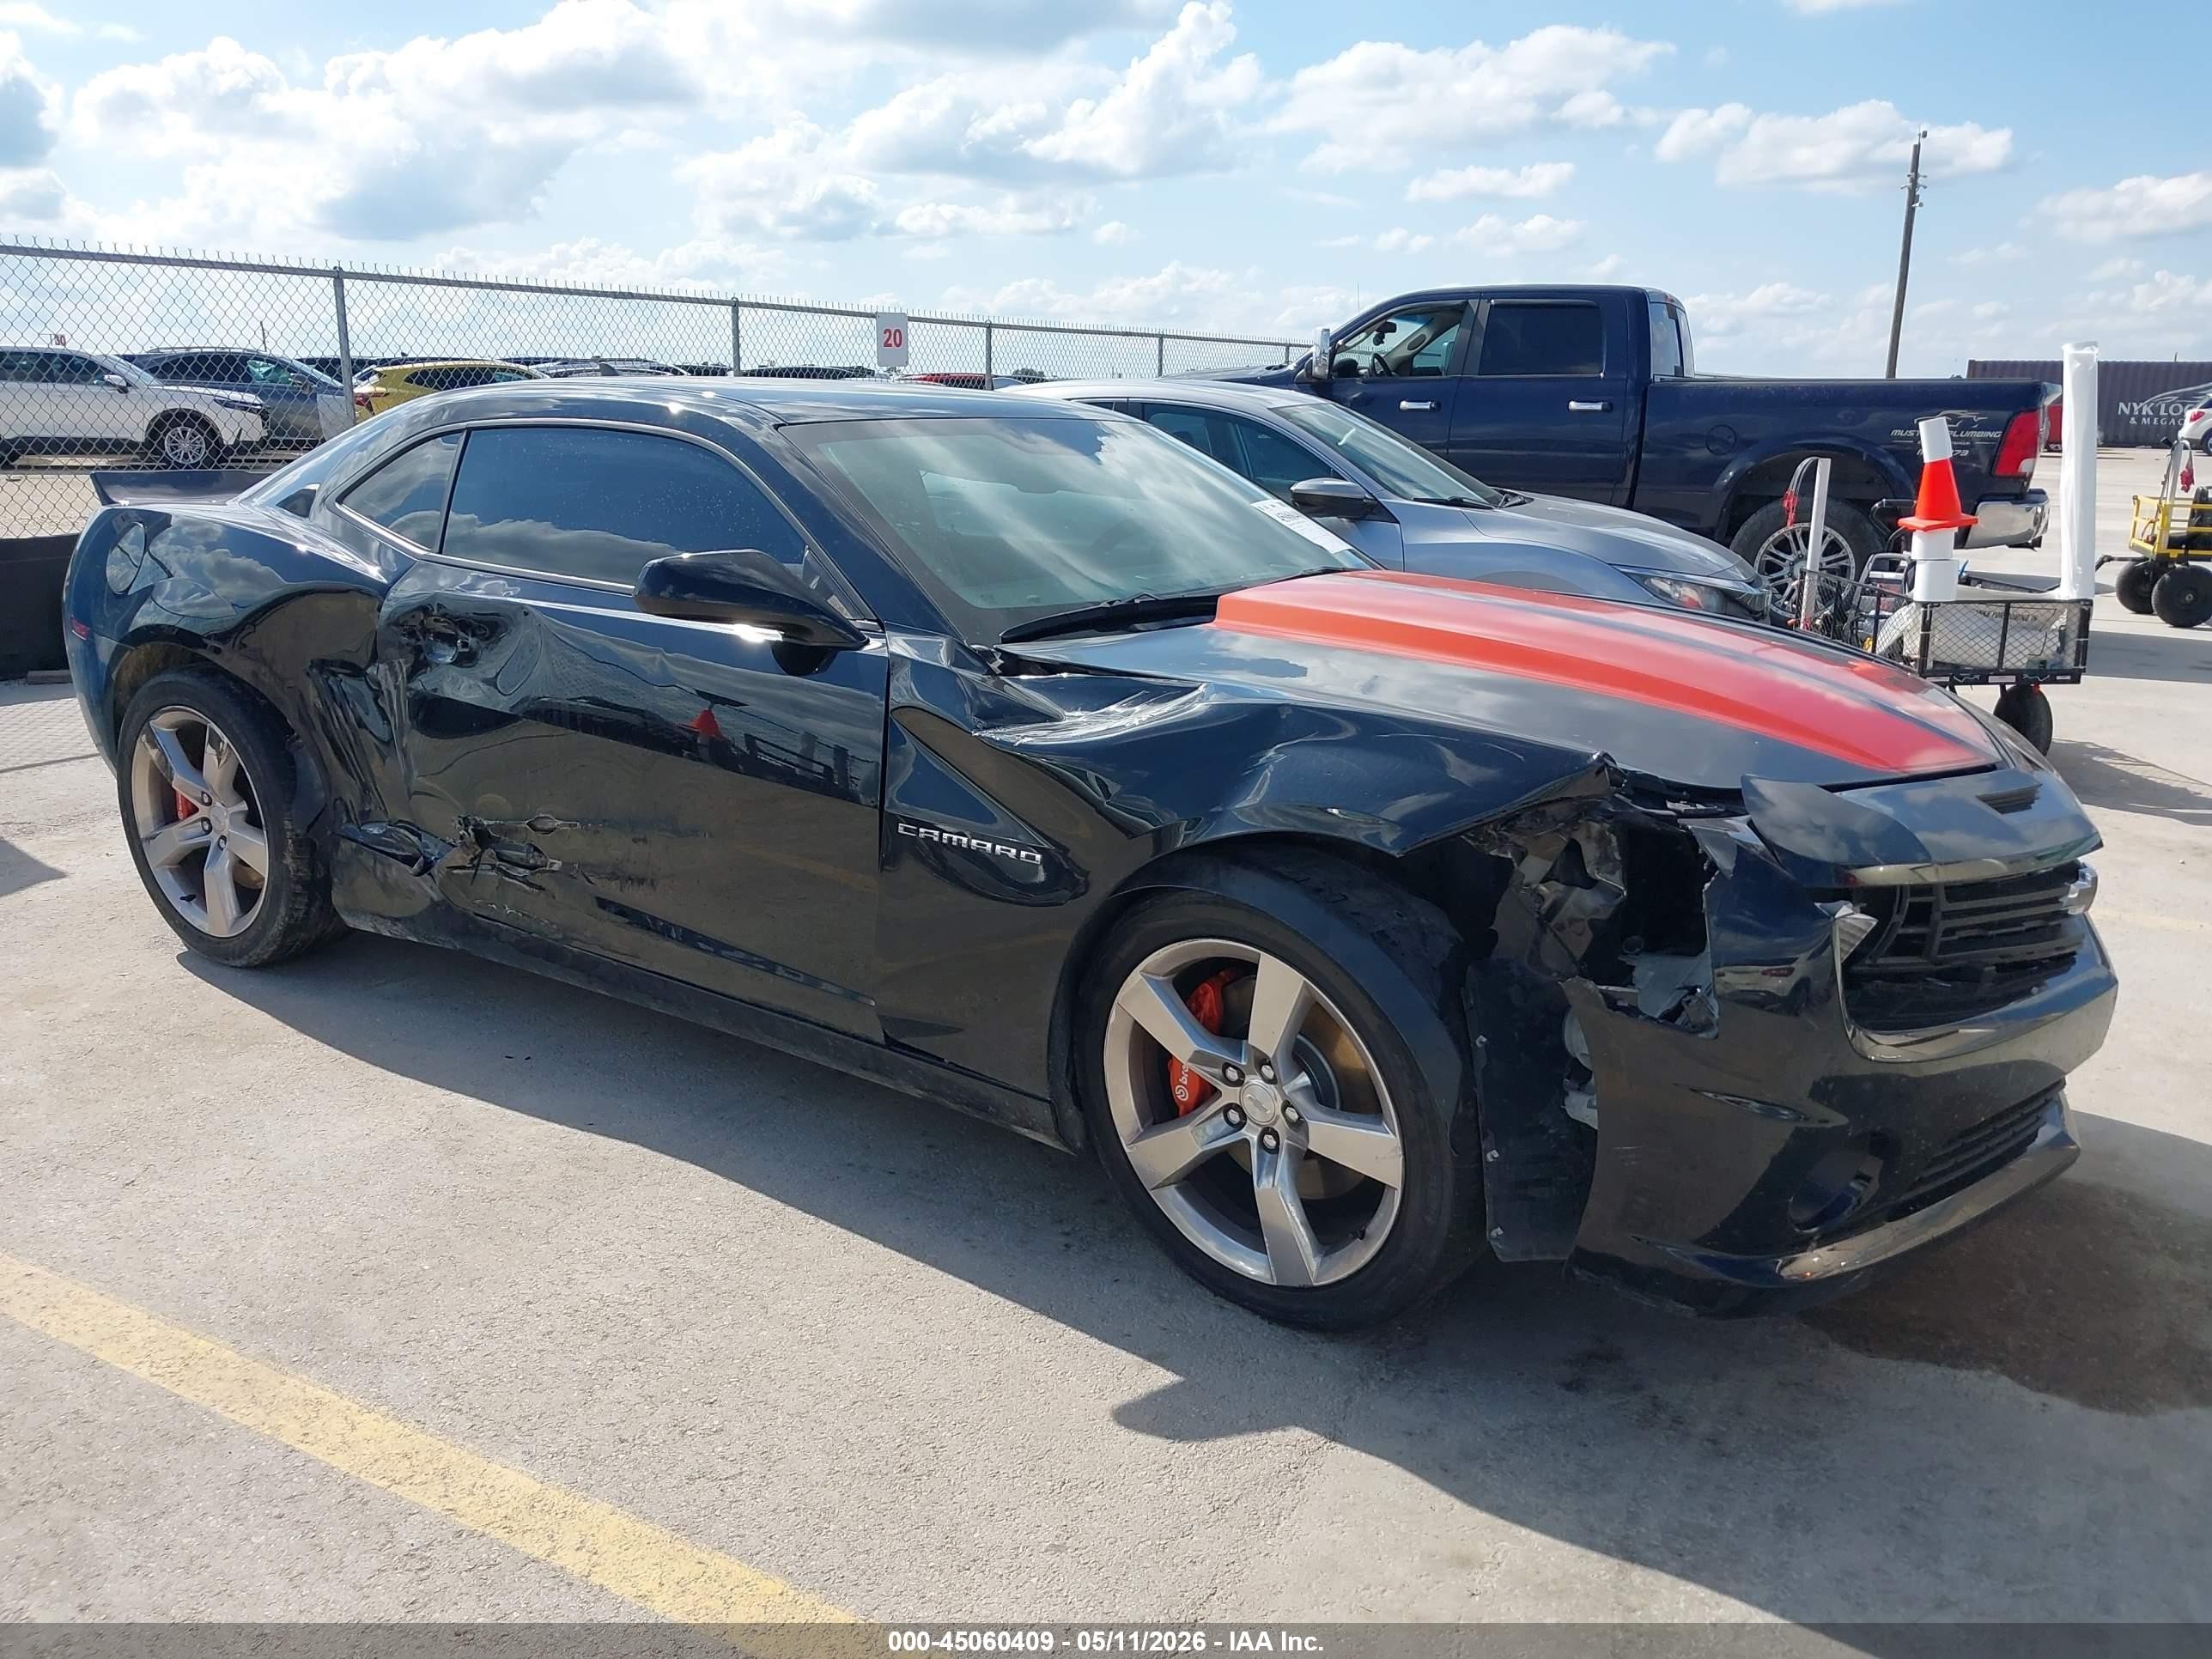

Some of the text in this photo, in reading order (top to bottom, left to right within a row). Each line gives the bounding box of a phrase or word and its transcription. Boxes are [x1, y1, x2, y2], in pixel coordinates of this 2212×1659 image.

[883, 328, 902, 348] 20
[2117, 401, 2154, 416] NYK
[897, 823, 1042, 865] CAMARO
